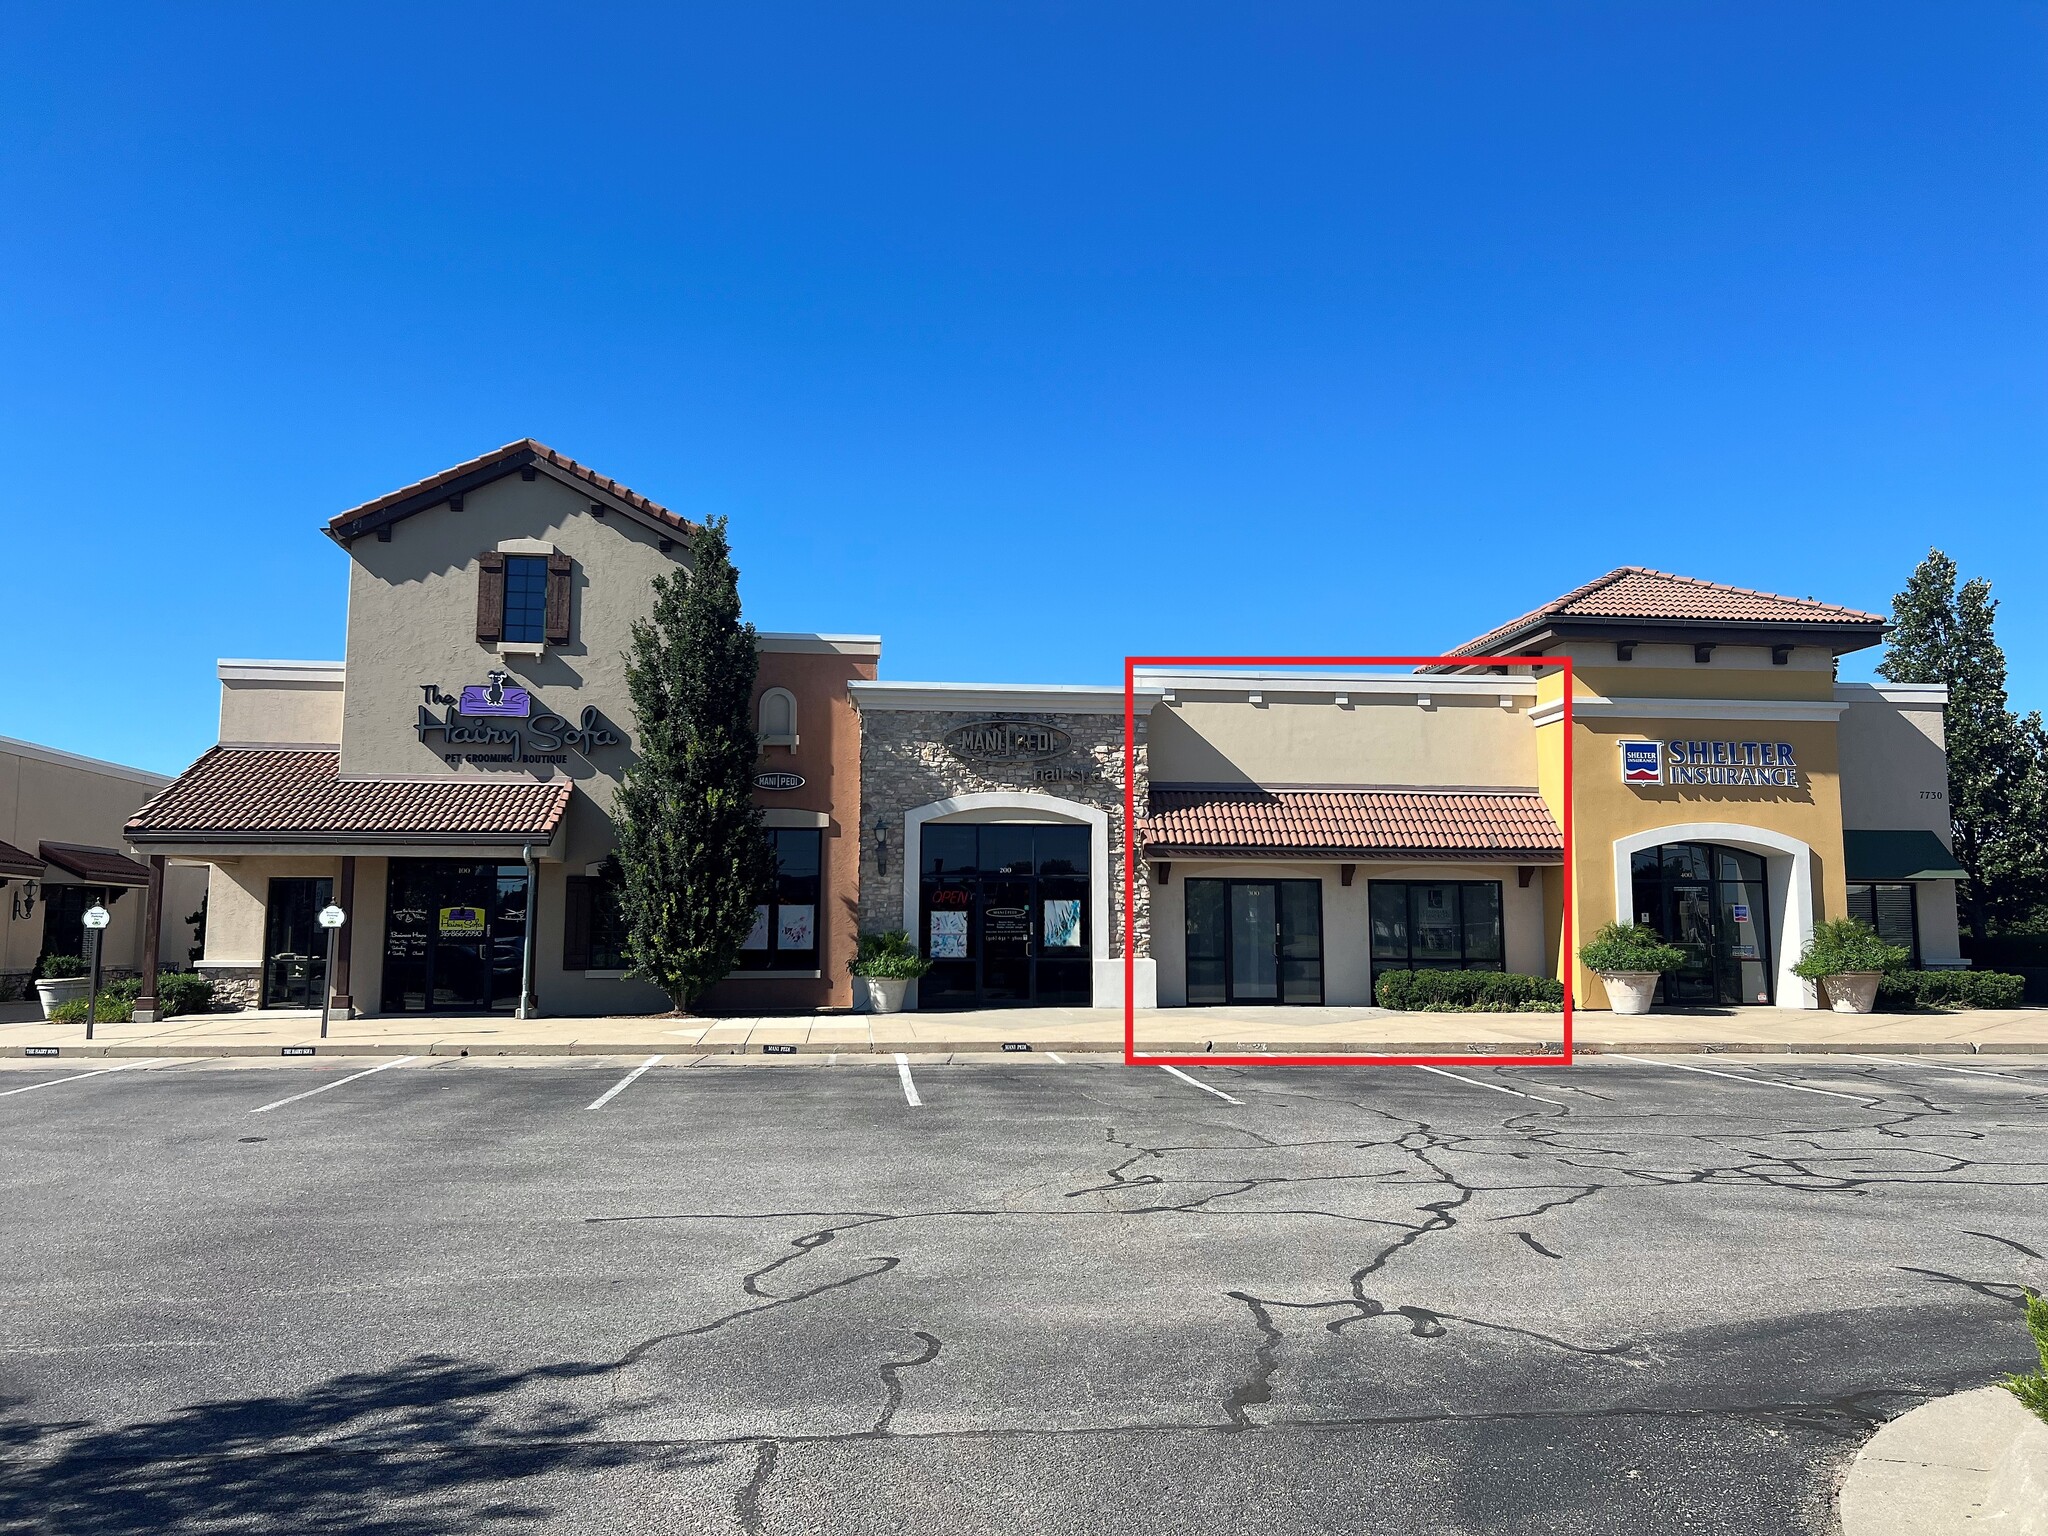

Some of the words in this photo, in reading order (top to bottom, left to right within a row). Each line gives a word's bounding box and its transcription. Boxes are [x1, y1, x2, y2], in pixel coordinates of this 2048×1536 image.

[419, 684, 458, 706] The
[413, 704, 521, 762] Hairy
[527, 705, 619, 756] Sofa
[961, 730, 1002, 750] MANI
[1015, 731, 1054, 751] PEDI
[445, 754, 462, 763] PET
[465, 754, 513, 763] GROOMING
[522, 754, 568, 764] BOUTIQUE
[1668, 740, 1797, 767] SHELTER
[759, 777, 777, 786] MANI
[780, 777, 798, 786] PEDI
[1033, 765, 1064, 781] nail
[1070, 768, 1103, 786] spa
[1669, 766, 1799, 788] INSURANCE
[1919, 791, 1943, 800] 7730
[932, 890, 969, 905] OPEN
